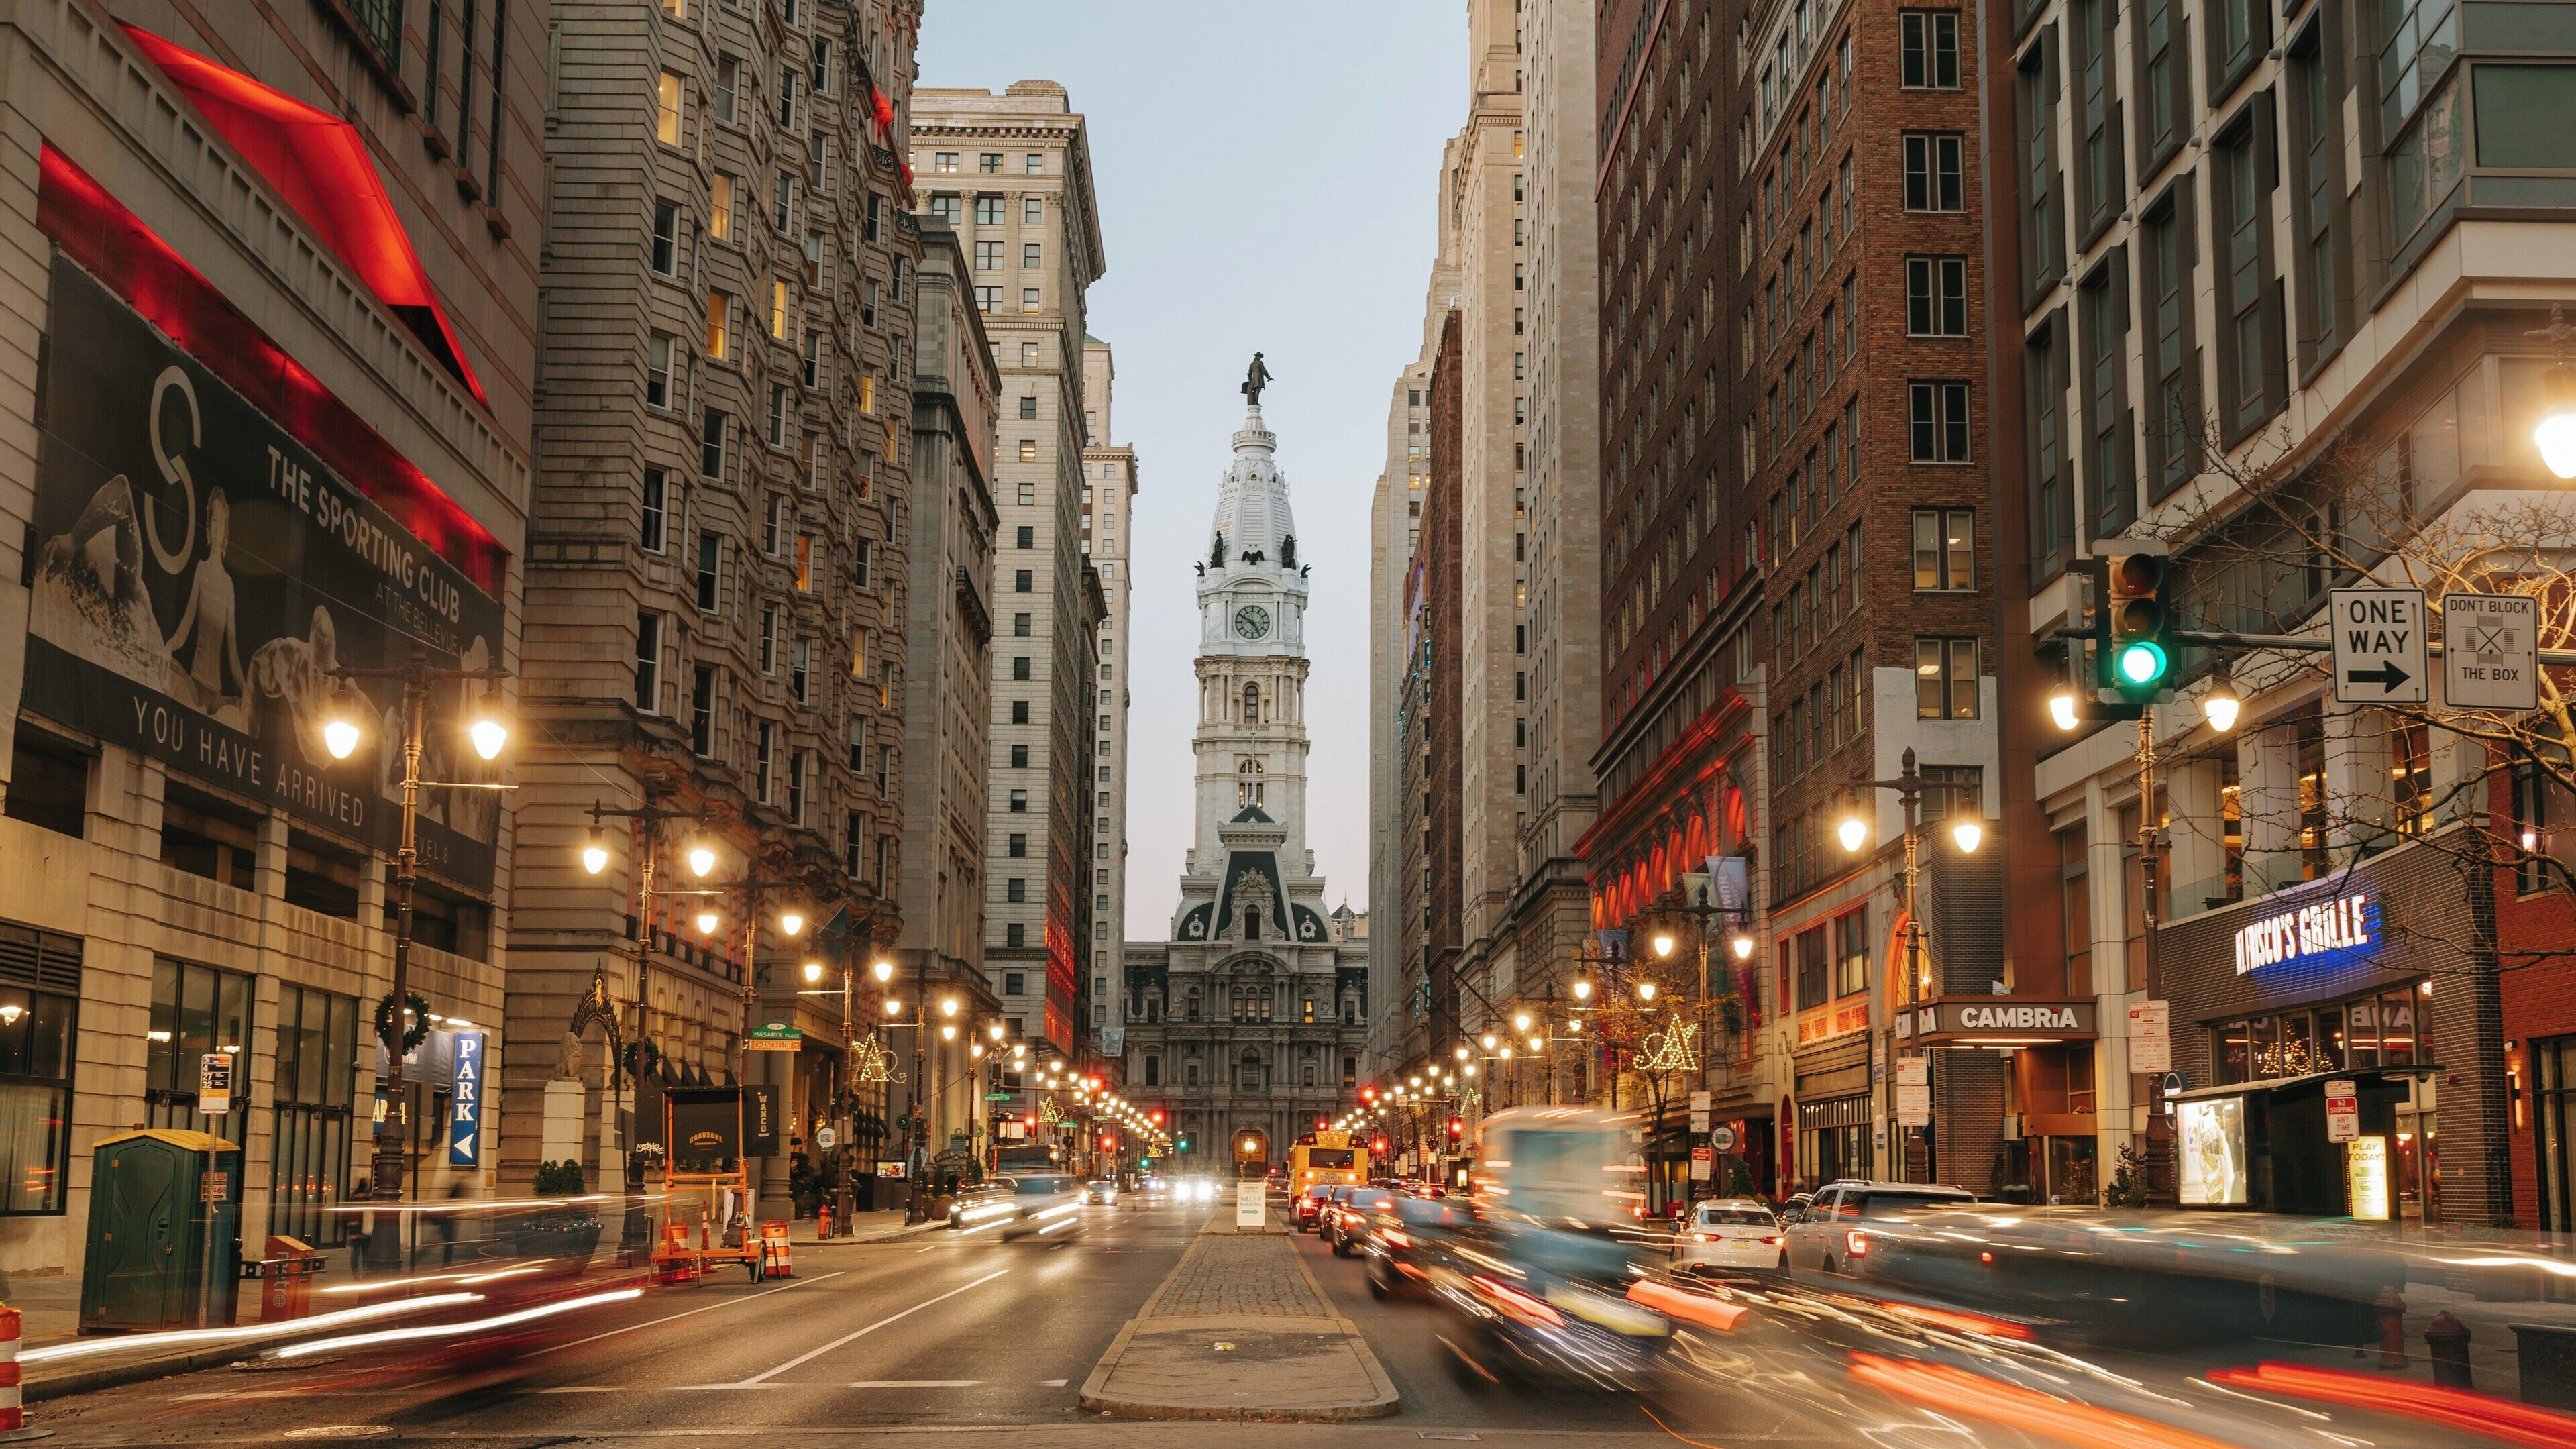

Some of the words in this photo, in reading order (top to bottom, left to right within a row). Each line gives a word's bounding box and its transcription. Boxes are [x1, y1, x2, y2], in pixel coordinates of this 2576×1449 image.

[143, 364, 202, 576] S
[268, 444, 311, 515] THE
[317, 486, 413, 589] SPORTING
[419, 565, 460, 624] CLUB
[2349, 600, 2407, 624] ONE
[2449, 599, 2485, 612] DON'T
[2489, 601, 2529, 614] BLOCK
[374, 581, 391, 606] AT
[393, 590, 411, 624] THE
[413, 607, 458, 655] BELLEVUE
[2348, 630, 2410, 654] WAY
[2461, 667, 2486, 680] THE
[2492, 668, 2519, 681] BOX
[134, 696, 184, 752] YOU
[201, 728, 262, 786] HAVE
[276, 763, 364, 828] ARRIVED
[2298, 894, 2369, 956] GRILLE
[753, 1041, 792, 1049] CHANCELLOR
[203, 1064, 209, 1072] 4
[203, 1073, 213, 1081] 27
[202, 1081, 212, 1089] 32
[455, 1039, 476, 1122] PARK
[759, 1095, 767, 1132] WANCO
[689, 1132, 723, 1143] CARUSONE
[1318, 1134, 1336, 1143] SCHOOL
[1338, 1135, 1347, 1143] BUS
[2349, 1152, 2385, 1161] TODAY!
